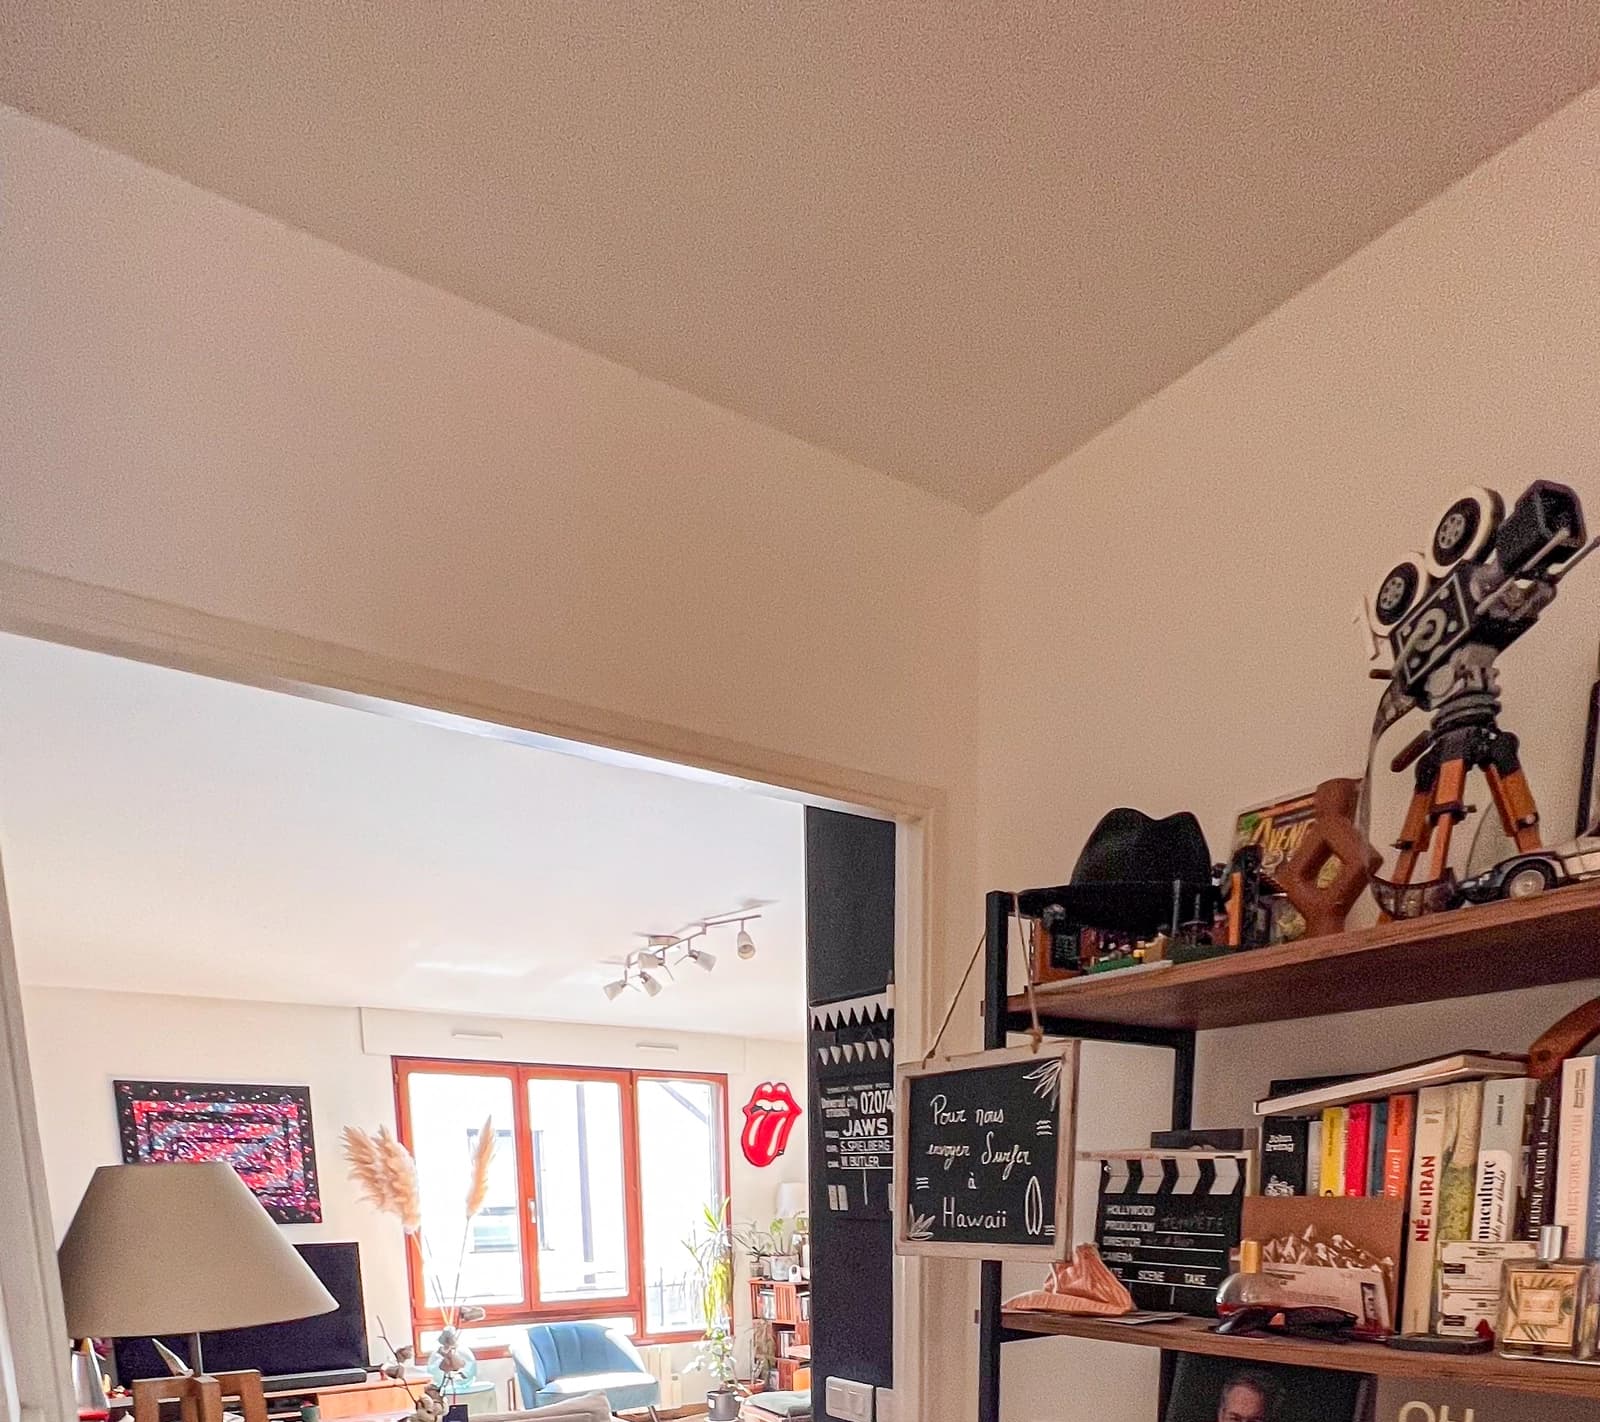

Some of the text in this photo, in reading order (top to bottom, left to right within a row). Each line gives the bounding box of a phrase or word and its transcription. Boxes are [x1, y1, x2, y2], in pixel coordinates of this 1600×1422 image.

[930, 1094, 1004, 1126] Pour nous
[842, 1118, 888, 1136] JAWS
[981, 1131, 1032, 1181] Surfer
[1419, 1155, 1436, 1196] IRAN
[1534, 1149, 1547, 1189] ACTEUR
[968, 1172, 978, 1189] à
[1106, 1205, 1155, 1216] HOLLYWOOD
[1476, 1161, 1496, 1241] maculture
[1530, 1192, 1544, 1224] JEUNE
[942, 1197, 1008, 1229] Hawaii
[1105, 1220, 1155, 1232] PRODUCTION
[1412, 1219, 1431, 1241] NÉ
[1102, 1236, 1141, 1246] DIRECTOR
[1102, 1252, 1132, 1262] CAMERA
[1138, 1270, 1165, 1282] SCENE
[1184, 1273, 1207, 1285] TAKE
